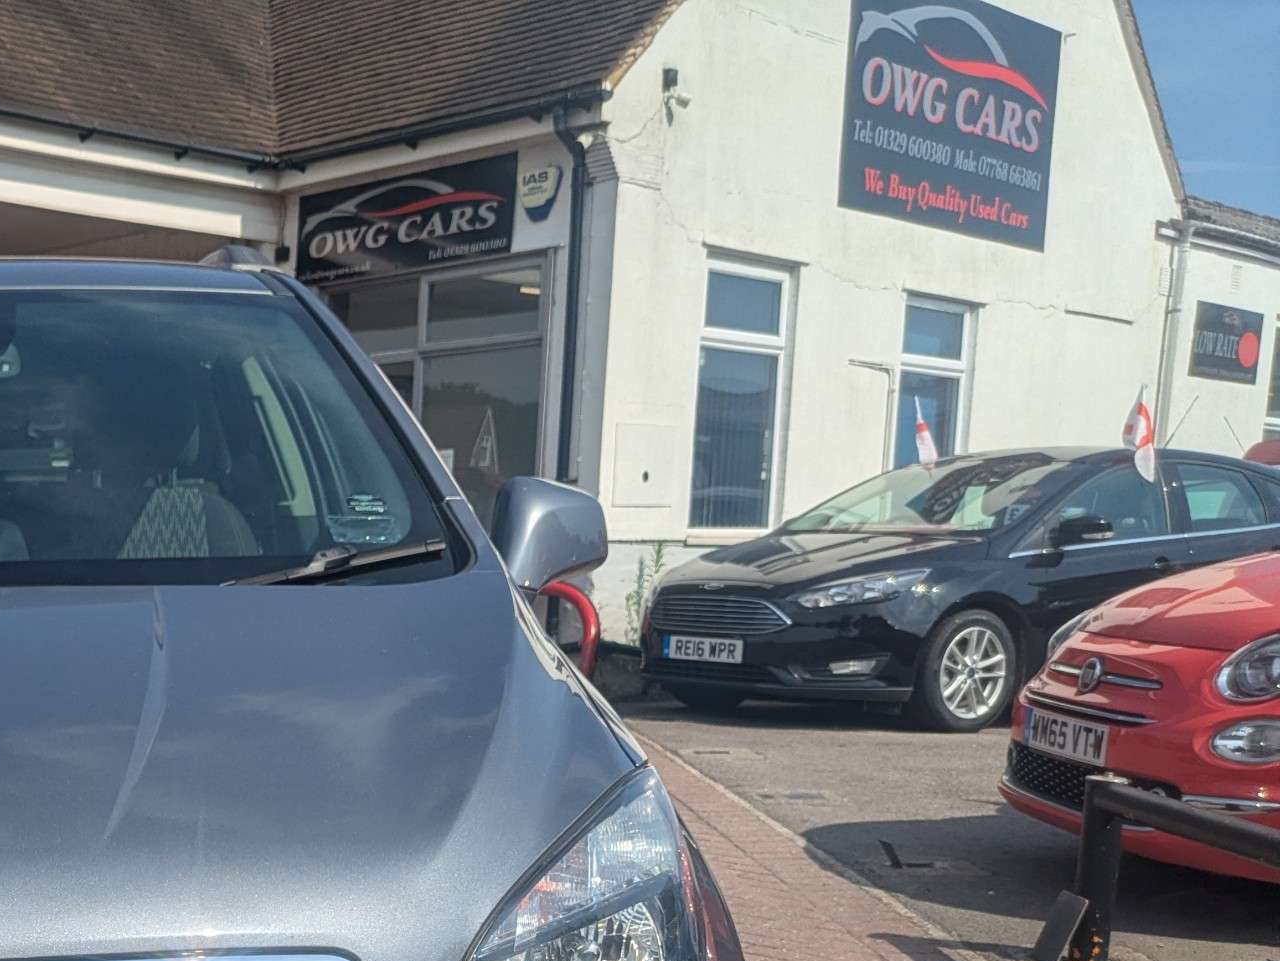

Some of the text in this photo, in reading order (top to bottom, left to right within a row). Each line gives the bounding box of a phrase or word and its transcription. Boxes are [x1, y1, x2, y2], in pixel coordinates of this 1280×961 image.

[862, 57, 1042, 153] OWG CARS
[853, 119, 872, 144] Tel:
[875, 126, 907, 154] 01329
[908, 136, 951, 166] 600380
[522, 171, 549, 186] IAS
[864, 167, 1029, 229] We Buy Quality Used Cars
[308, 200, 499, 259] OWG CARS
[675, 639, 737, 660] RE16 WPR
[1031, 713, 1105, 760] WM65 VTW
